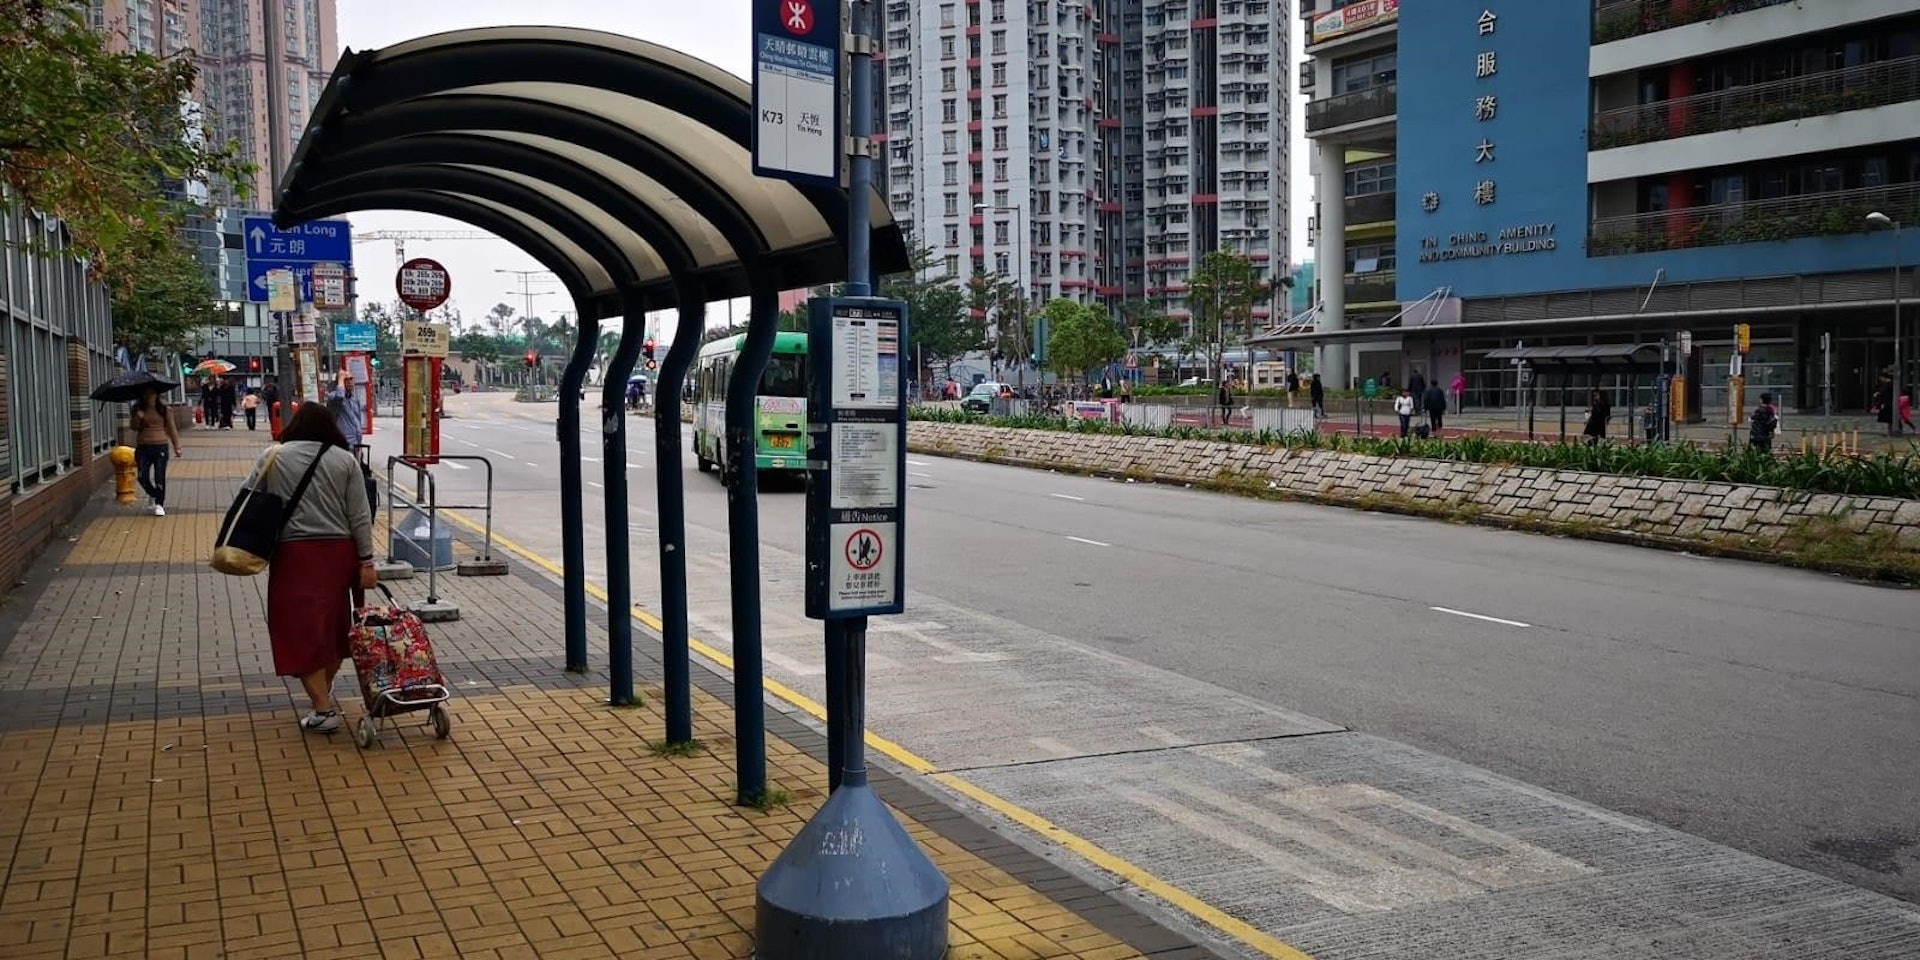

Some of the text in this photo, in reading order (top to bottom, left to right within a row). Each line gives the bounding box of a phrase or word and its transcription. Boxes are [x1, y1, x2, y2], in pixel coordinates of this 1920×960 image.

[1474, 9, 1498, 206] 合服務大樓
[762, 109, 784, 125] K73
[797, 124, 806, 132] Tin
[304, 224, 337, 237] Long
[1421, 223, 1556, 249] TIN CHING AMENITY
[269, 238, 306, 255] 元朗
[1439, 243, 1504, 261] COMMUNITY
[1503, 238, 1556, 254] BUILDING
[861, 512, 888, 521] Notice
